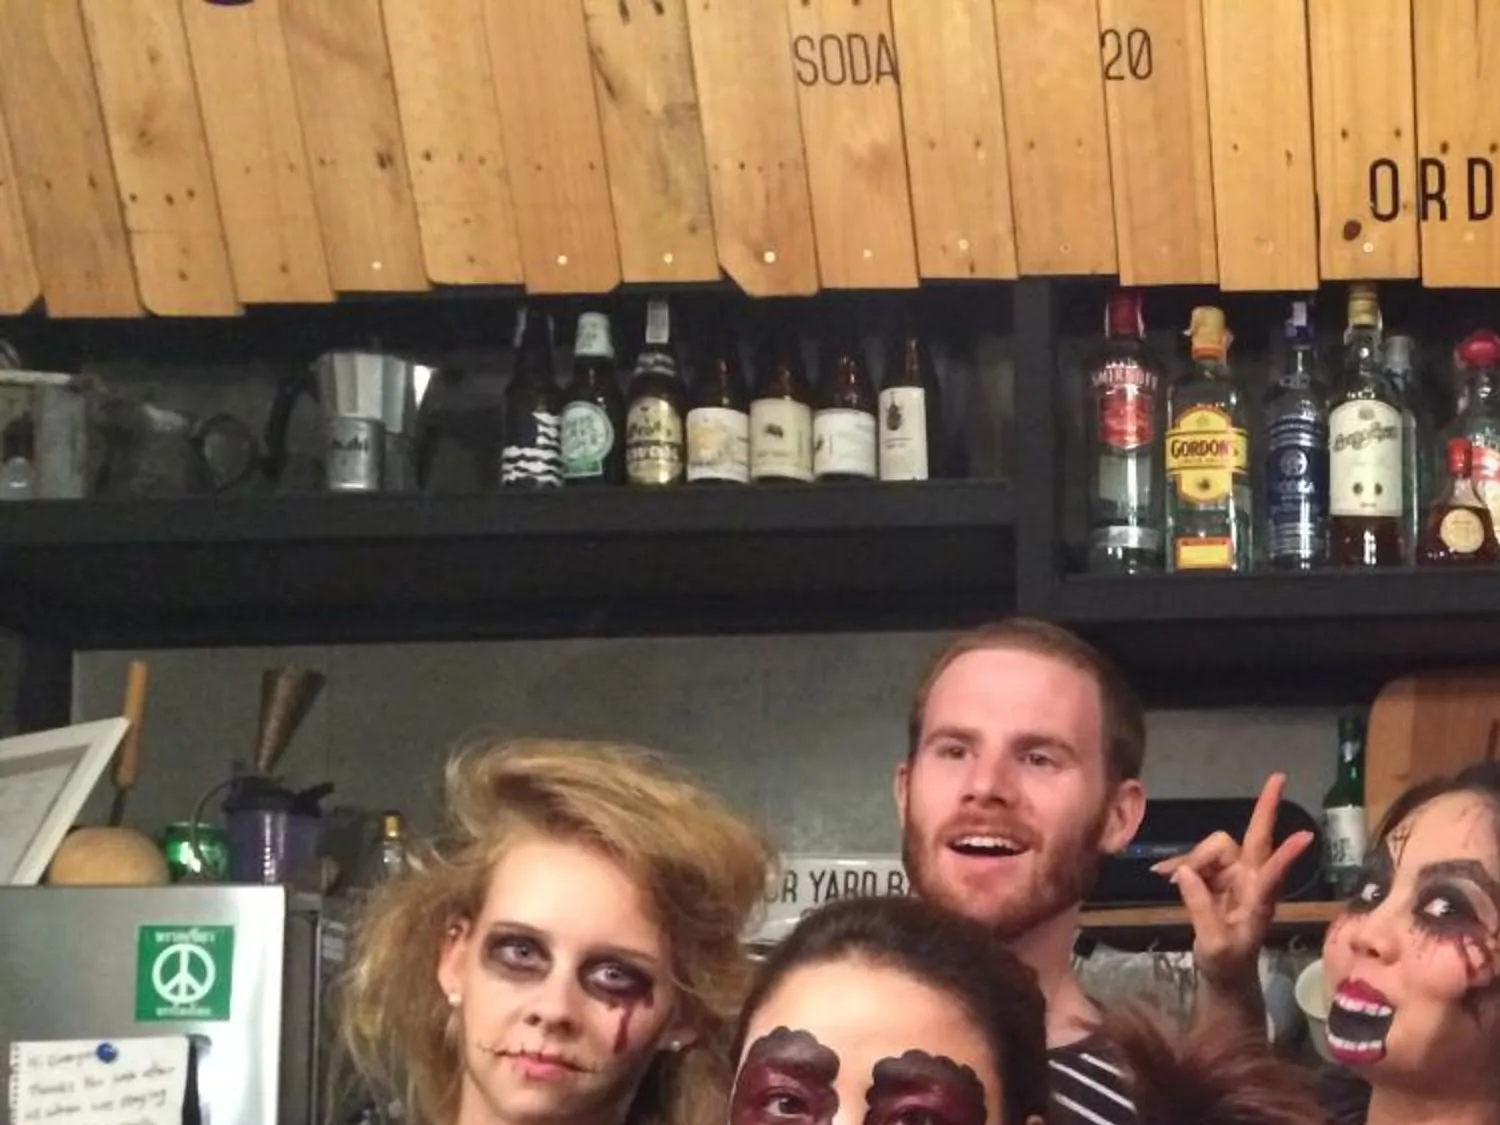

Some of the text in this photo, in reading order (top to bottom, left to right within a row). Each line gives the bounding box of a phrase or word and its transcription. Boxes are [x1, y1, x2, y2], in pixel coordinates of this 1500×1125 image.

[792, 28, 1153, 87] SODA 20
[810, 870, 876, 902] YARD
